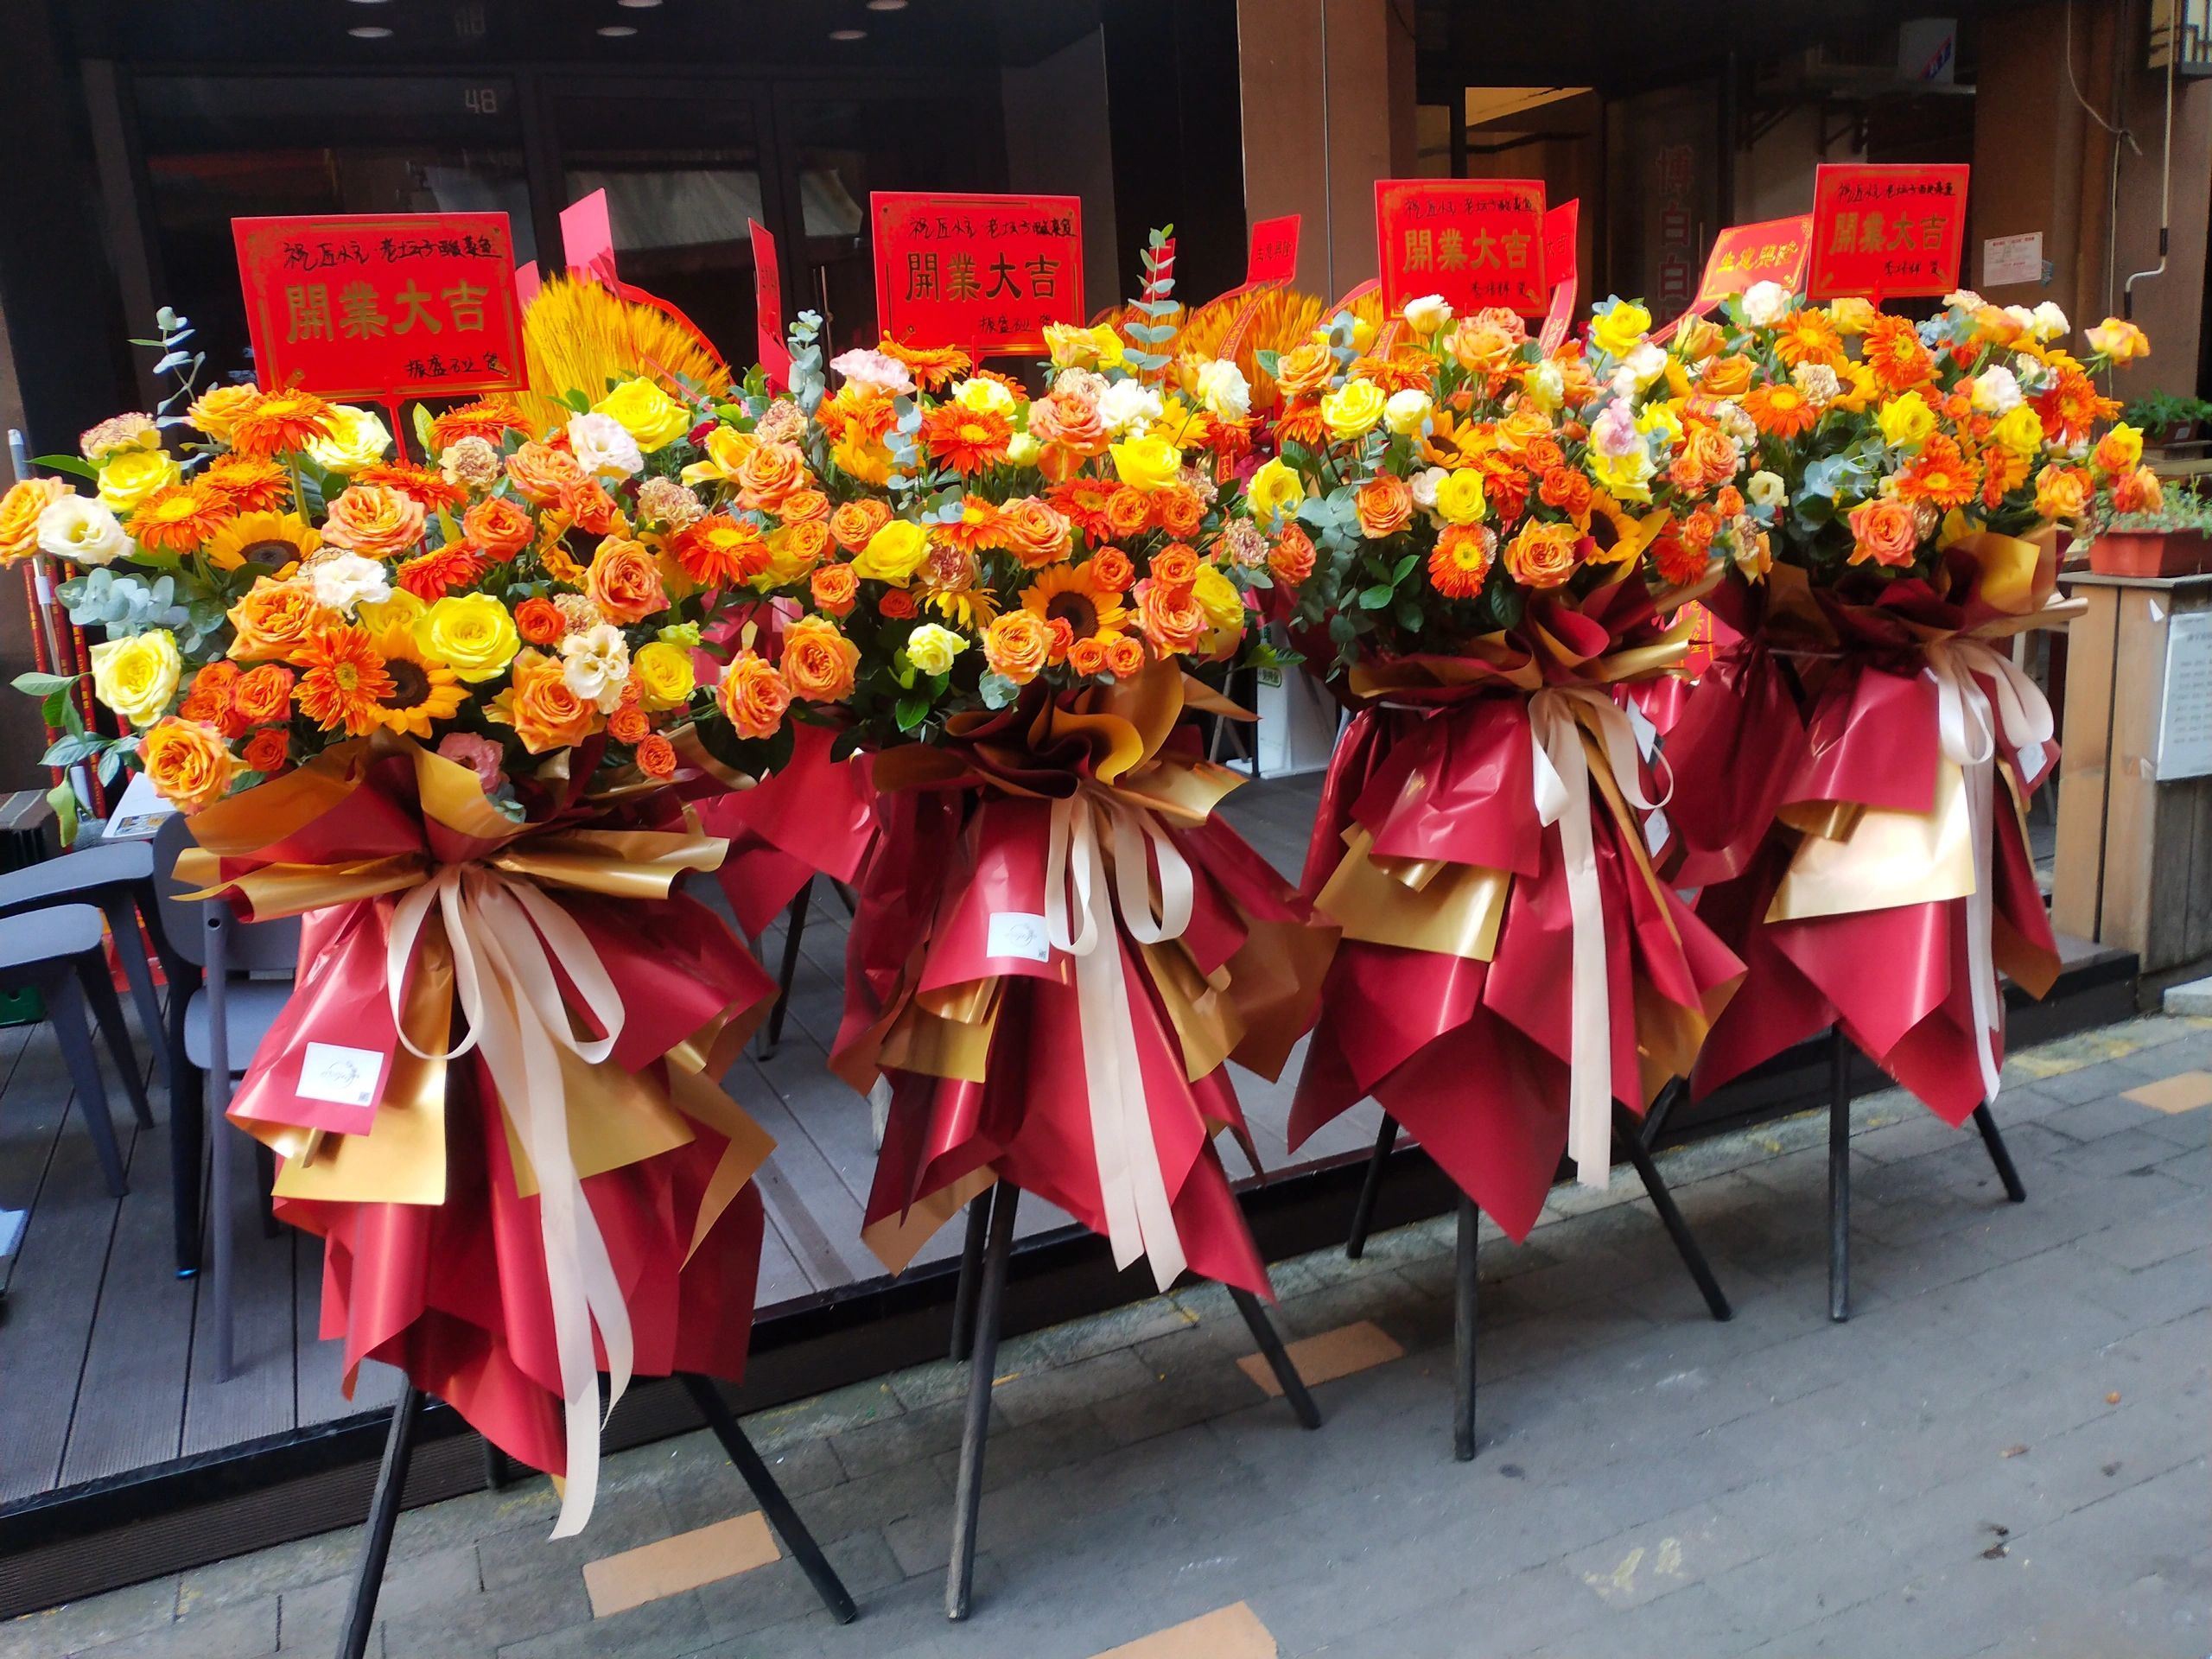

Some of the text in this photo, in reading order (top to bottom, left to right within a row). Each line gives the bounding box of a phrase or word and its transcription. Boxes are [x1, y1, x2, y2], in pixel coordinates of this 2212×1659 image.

[464, 88, 499, 114] 48
[1403, 226, 1532, 274] 開業大吉
[1828, 212, 1948, 257] 開業大吉
[905, 251, 1062, 302] 開業大吉
[285, 277, 490, 345] 開業大吉
